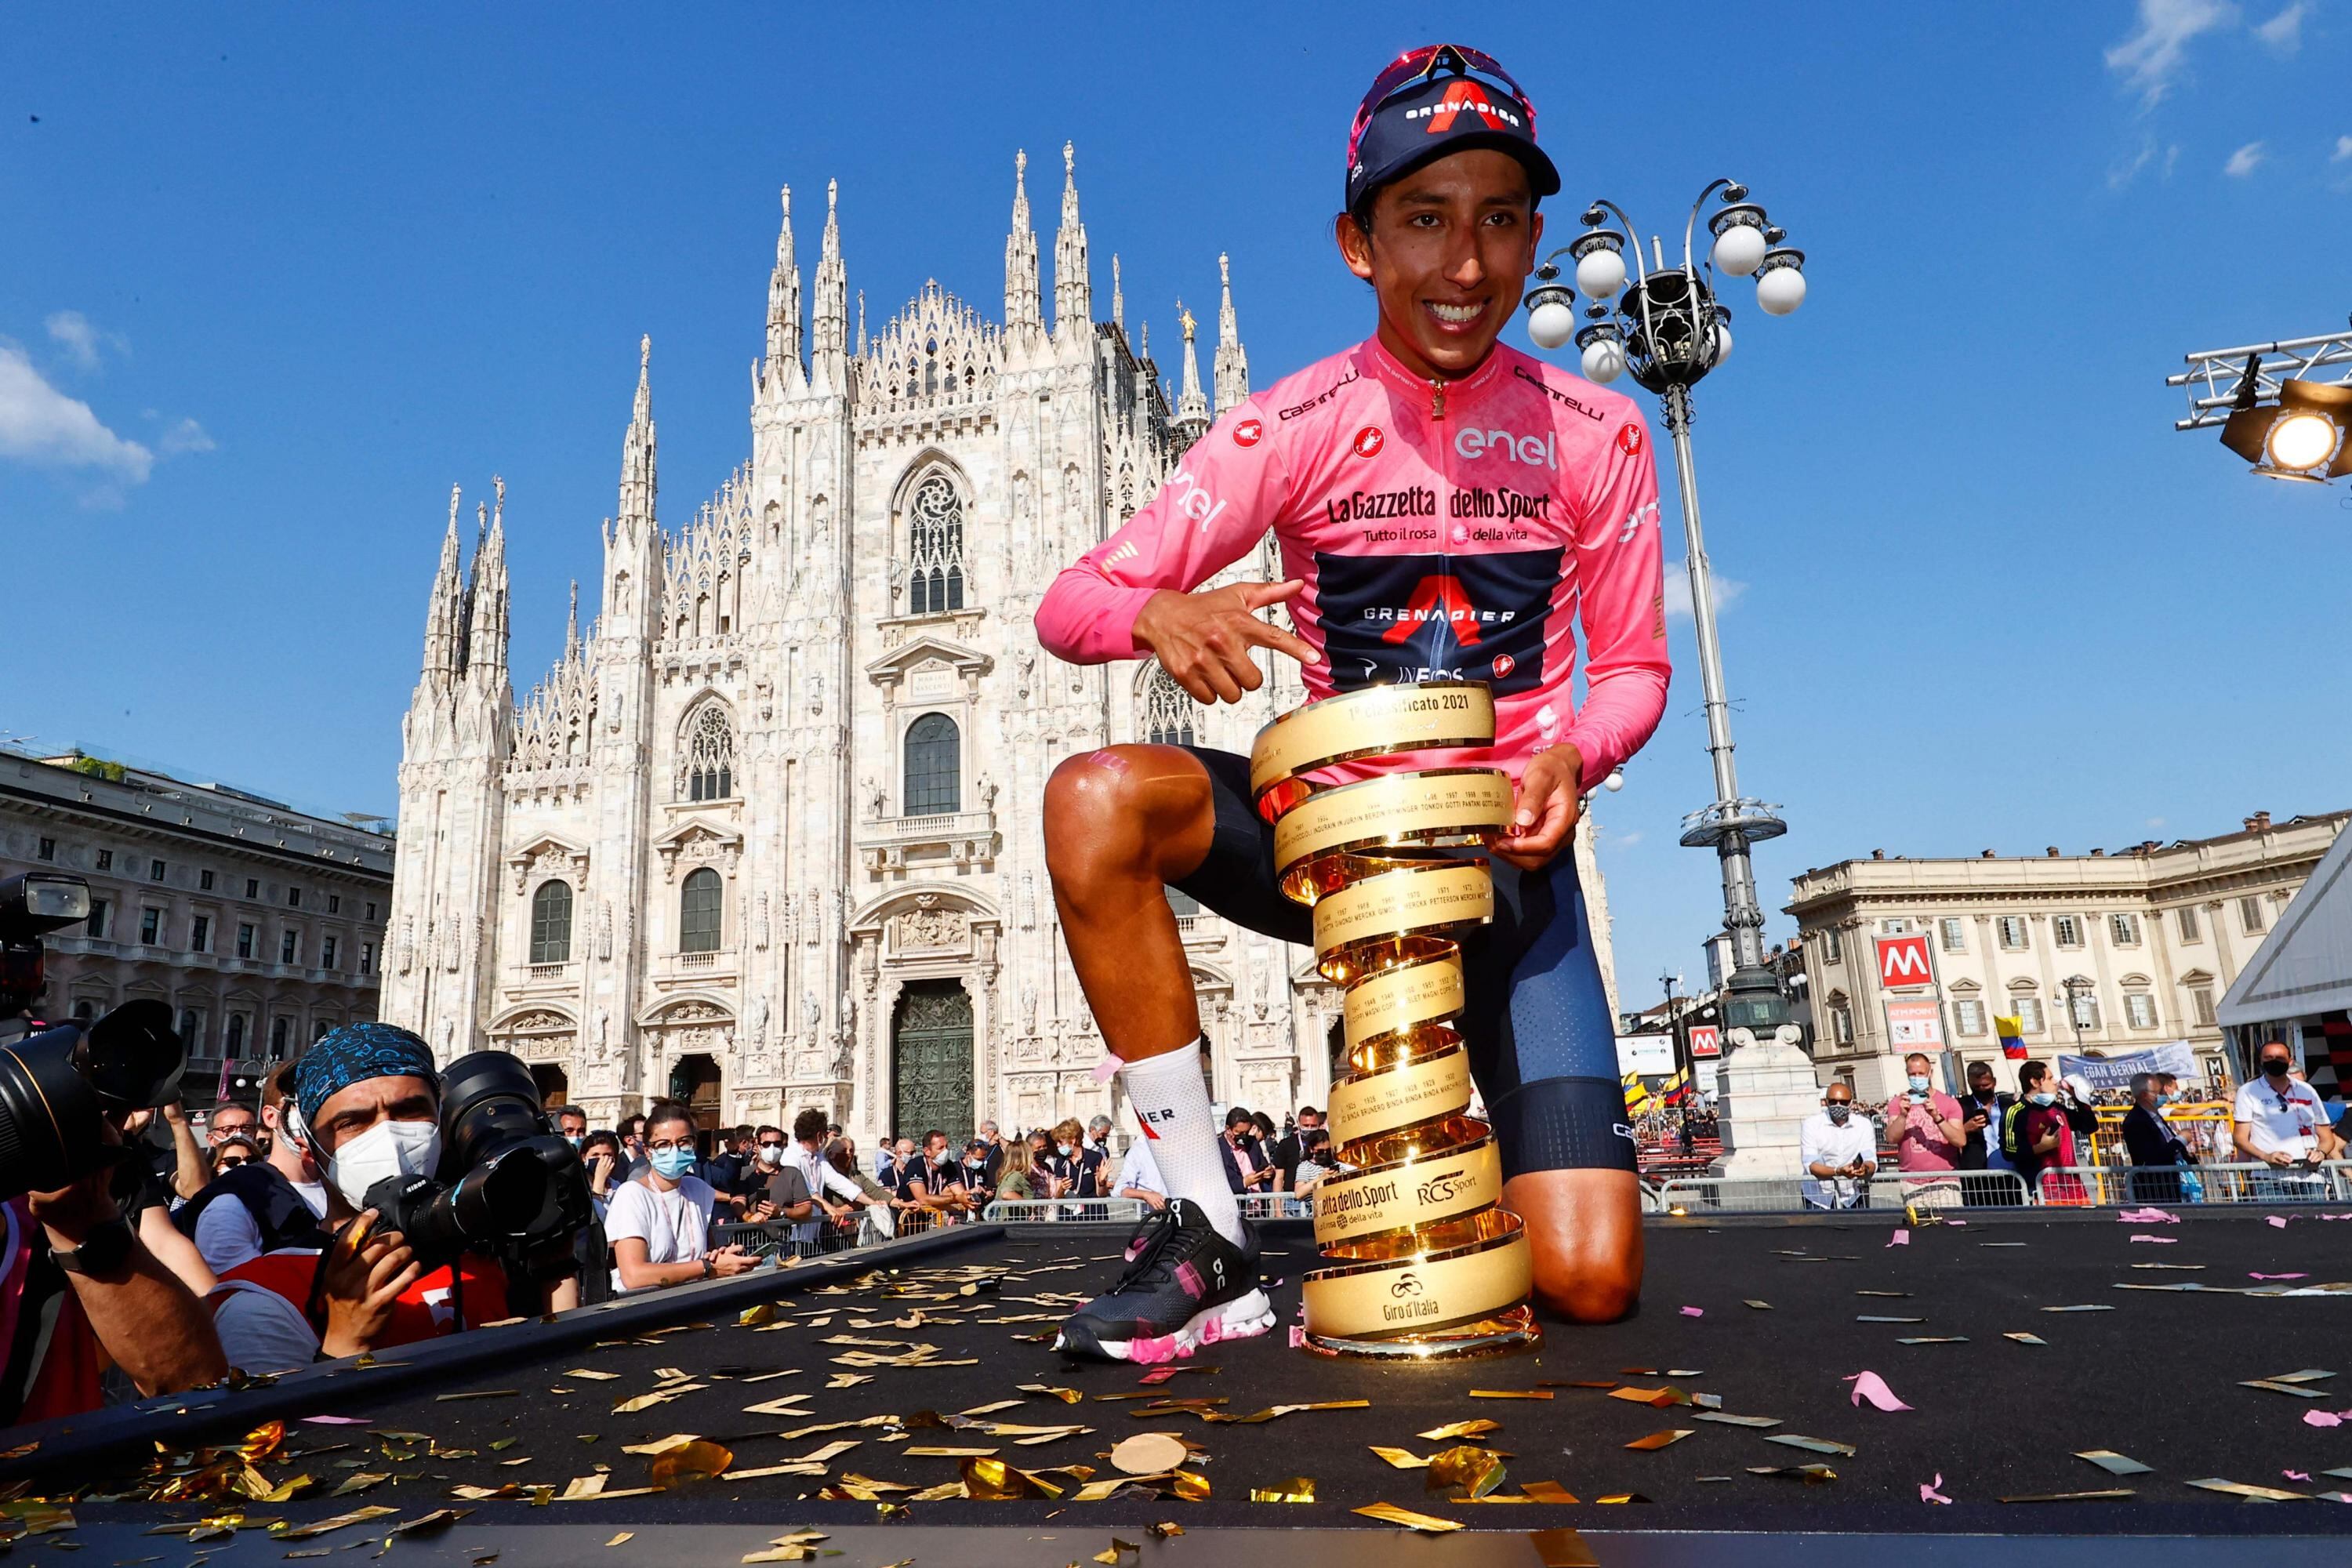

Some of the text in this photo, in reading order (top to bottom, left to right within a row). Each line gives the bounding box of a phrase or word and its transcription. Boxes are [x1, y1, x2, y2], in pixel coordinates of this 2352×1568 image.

[1406, 100, 1519, 127] GRENADIER
[1454, 426, 1557, 471] enel
[1327, 485, 1552, 524] La Gazzetta dello Sport
[1363, 528, 1437, 543] Tutto il rosa
[1472, 528, 1528, 541] della vita
[1363, 607, 1516, 623] GRENADIER
[1396, 666, 1465, 684] INEOS
[1442, 694, 1469, 710] 2021
[1421, 803, 1443, 811] TONKOV
[1437, 886, 1450, 895] 1971
[1429, 895, 1460, 905] PETTERSON
[1884, 945, 1929, 978] M
[1422, 981, 1435, 990] 1951
[1421, 989, 1439, 1000] MAGNI
[1889, 1007, 1937, 1018] ATM POINT
[1693, 1032, 1718, 1051] M
[2083, 1062, 2152, 1079] EGAN BERNAL
[1385, 1089, 1399, 1098] 1927
[1423, 1078, 1436, 1087] 1929
[1360, 1104, 1385, 1117] BRUNERO
[1385, 1099, 1404, 1109] BINDA
[1405, 1094, 1423, 1104] BINDA
[1423, 1087, 1439, 1098] BINDA
[405, 1179, 426, 1193] Nikon
[1417, 1175, 1477, 1207] RCS Sport
[1338, 1189, 1363, 1212] dello
[1363, 1180, 1399, 1208] Sport
[1348, 1210, 1384, 1224] della vita
[1383, 1298, 1439, 1321] Giro d'Italia
